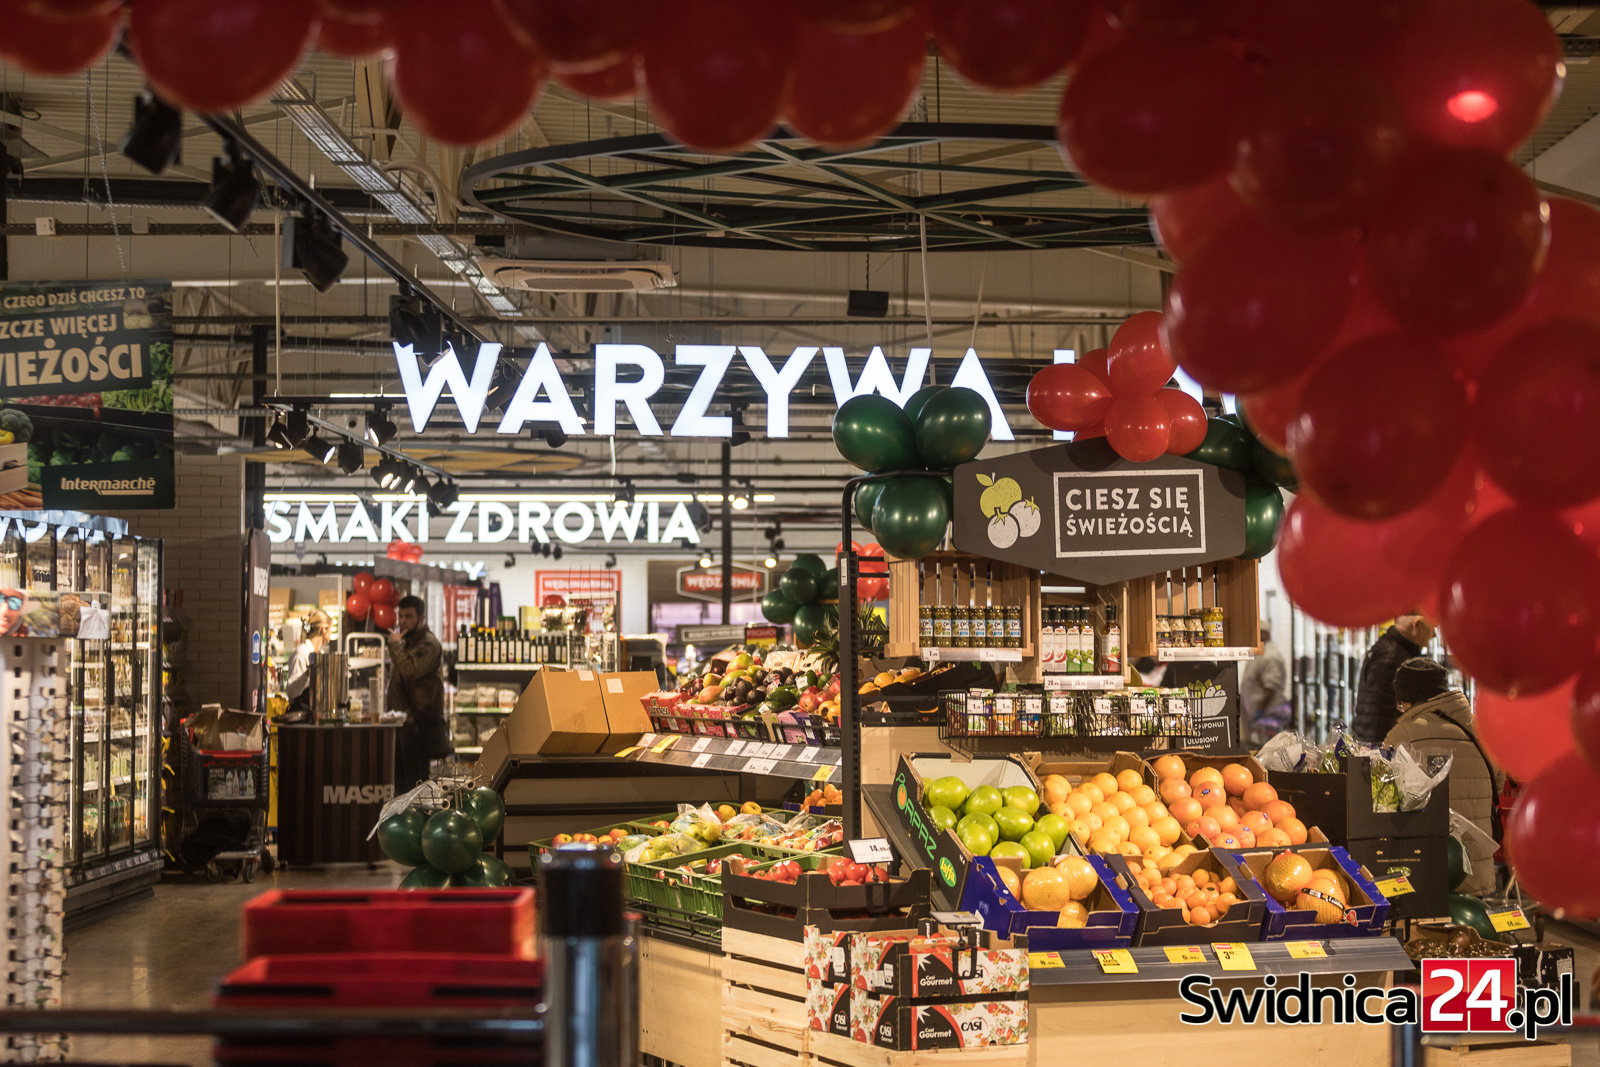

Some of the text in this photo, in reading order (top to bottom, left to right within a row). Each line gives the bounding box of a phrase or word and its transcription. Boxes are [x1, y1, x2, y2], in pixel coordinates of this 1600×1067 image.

[4, 286, 146, 309] CZEGO DZIŚ CHCESZ TO
[50, 313, 118, 339] WIĘCEJ
[392, 341, 1016, 441] WARZYWA
[60, 476, 156, 495] Intermarché
[1065, 485, 1191, 514] CIESZ SIĘ
[263, 499, 701, 544] SMAKI ZDROWIA
[1065, 514, 1194, 538] ŚWIEŻOŚCIĄ
[686, 574, 759, 591] WĘDZRNIA
[920, 976, 954, 987] Gourmet
[962, 969, 984, 979] CSI
[919, 1030, 952, 1040] Gourmet
[960, 1021, 983, 1032] CASI
